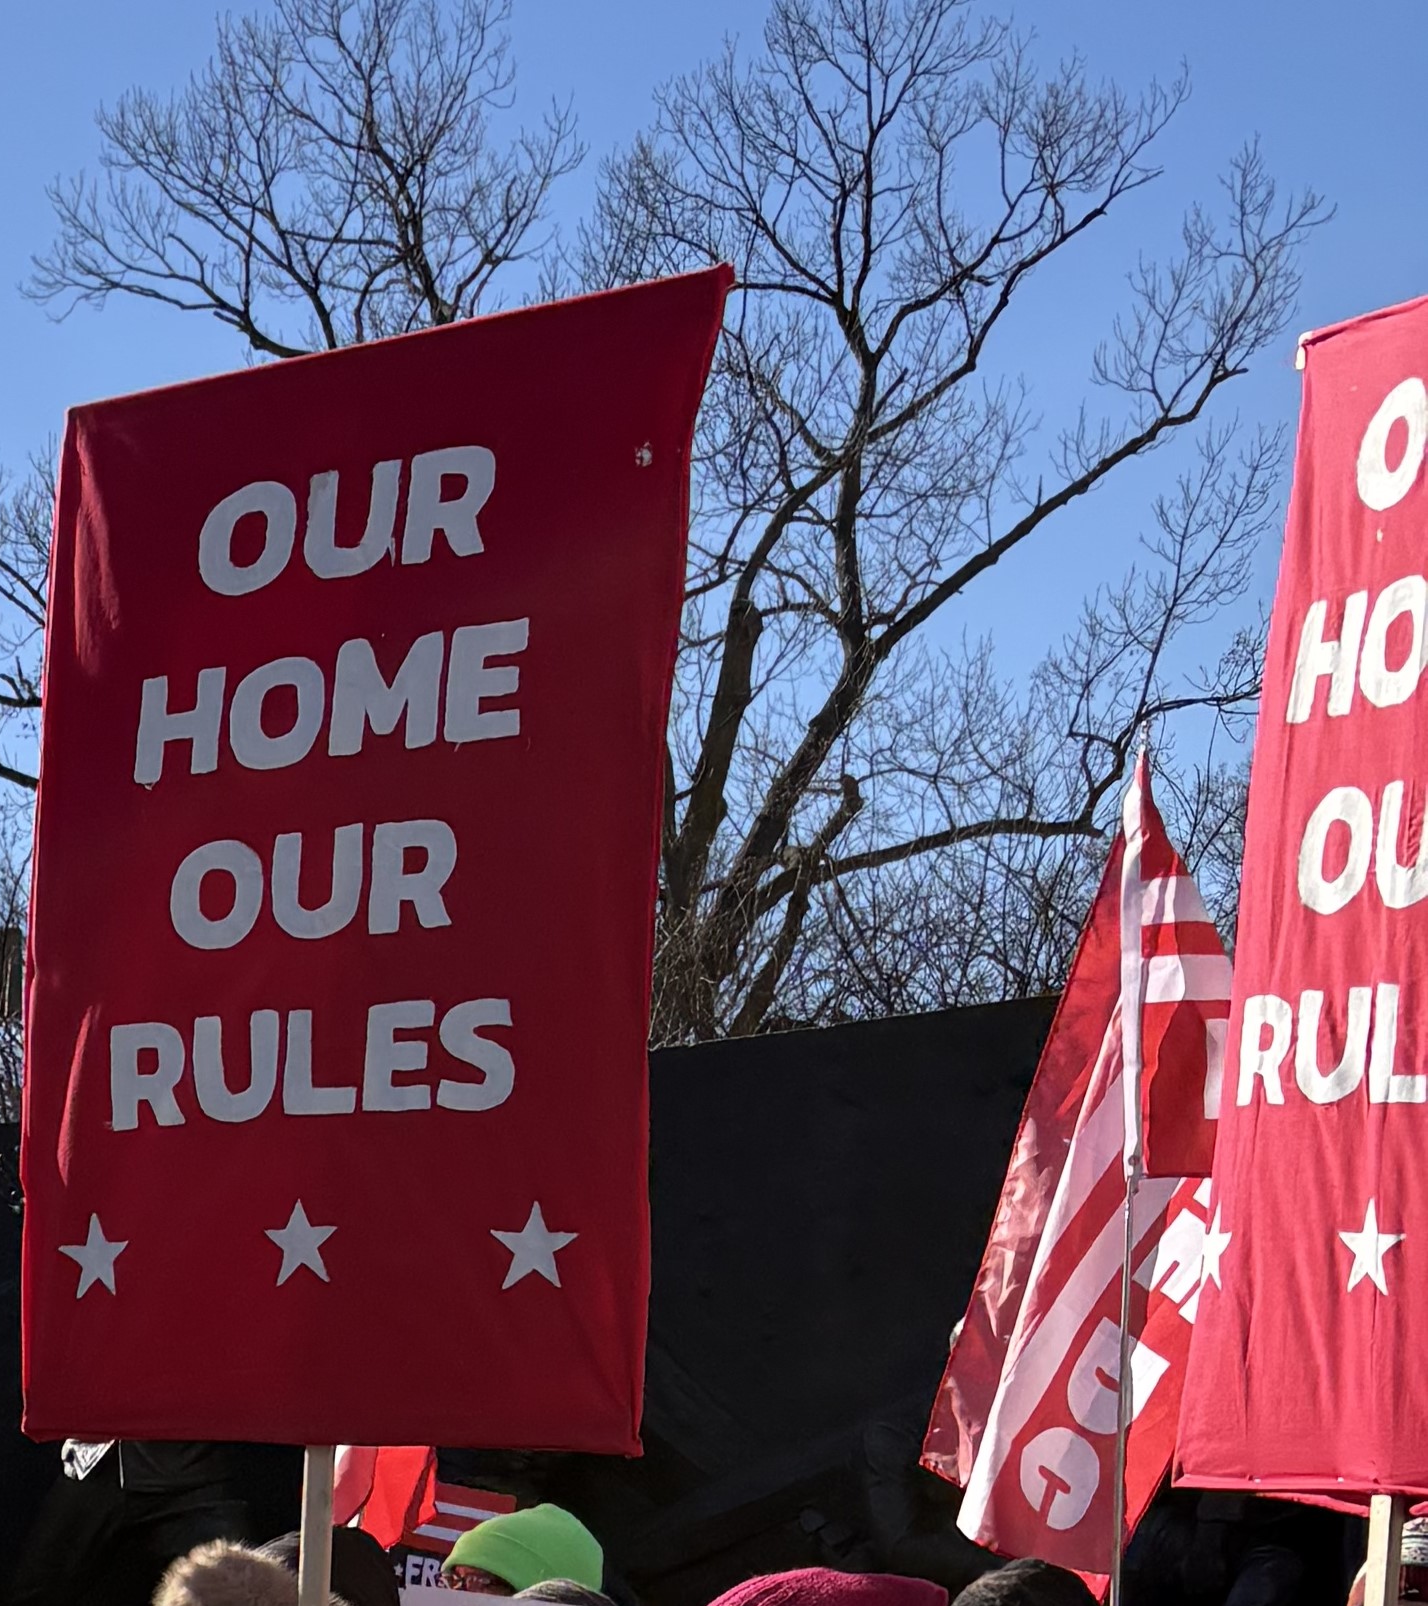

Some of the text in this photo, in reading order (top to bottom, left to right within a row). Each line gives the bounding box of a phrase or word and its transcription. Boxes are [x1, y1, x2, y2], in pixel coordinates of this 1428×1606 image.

[199, 445, 496, 595] OUR
[134, 617, 530, 788] HOME
[1285, 575, 1428, 724] HO
[170, 819, 457, 950] OUR
[1299, 780, 1428, 915] OU
[109, 998, 515, 1131] RULES
[1236, 983, 1428, 1106] RUL
